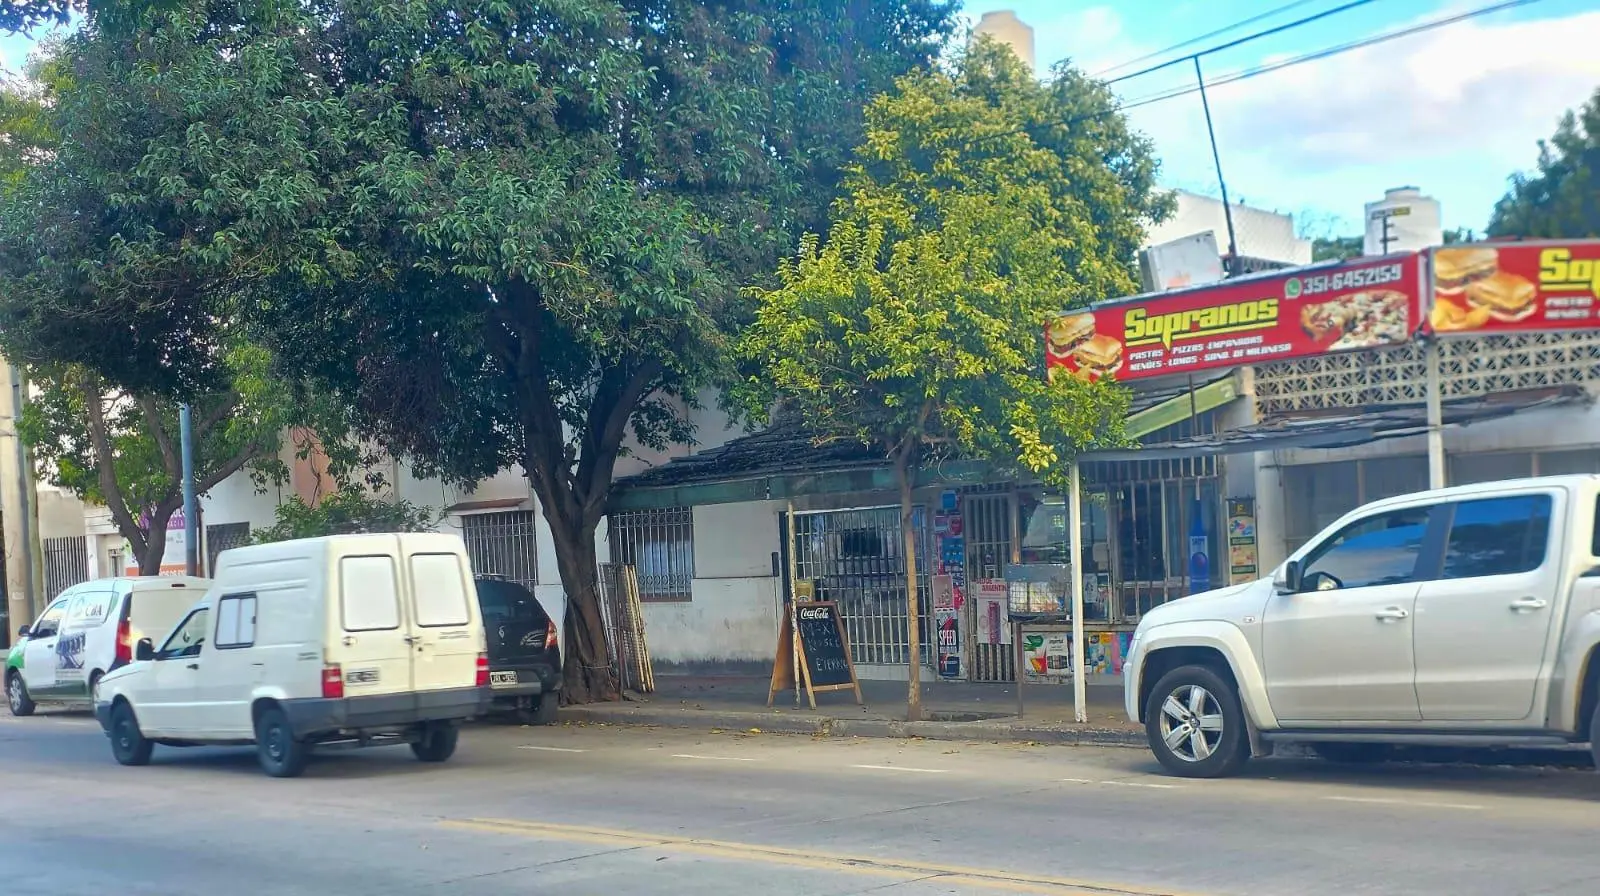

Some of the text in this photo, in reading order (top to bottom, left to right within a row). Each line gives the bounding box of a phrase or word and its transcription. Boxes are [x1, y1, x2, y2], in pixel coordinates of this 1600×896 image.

[1303, 263, 1402, 294] 351-6452159
[1124, 298, 1279, 350] Sopranos
[1129, 349, 1164, 361] PASTAS
[1171, 343, 1204, 355] PIZZAS
[1168, 355, 1198, 367] LOMOS
[1246, 342, 1292, 356] MILANESA
[938, 629, 957, 646] SPEED
